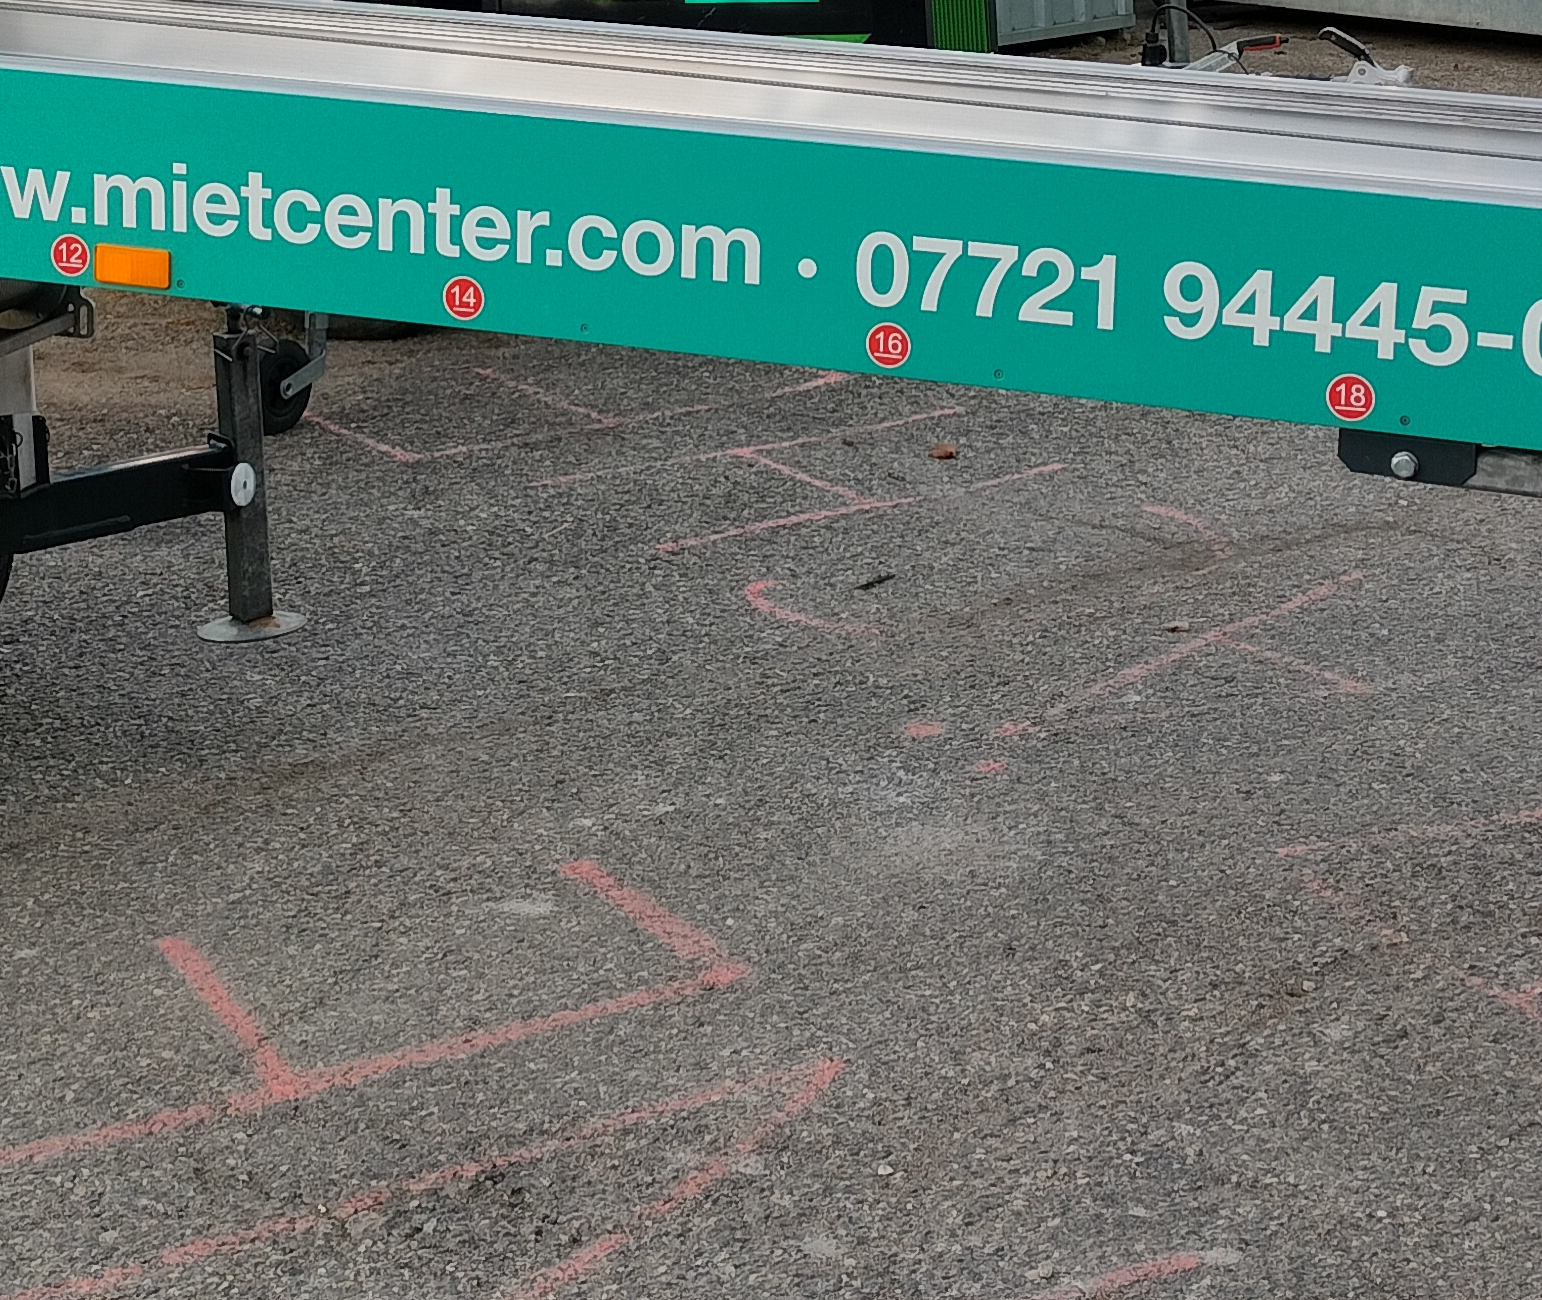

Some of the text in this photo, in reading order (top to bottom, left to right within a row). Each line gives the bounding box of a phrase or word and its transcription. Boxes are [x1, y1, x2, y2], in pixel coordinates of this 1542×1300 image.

[57, 242, 83, 264] 12
[856, 230, 1117, 331] 07721
[449, 285, 477, 308] 14
[874, 331, 902, 355] 16
[1334, 383, 1367, 408] 18
